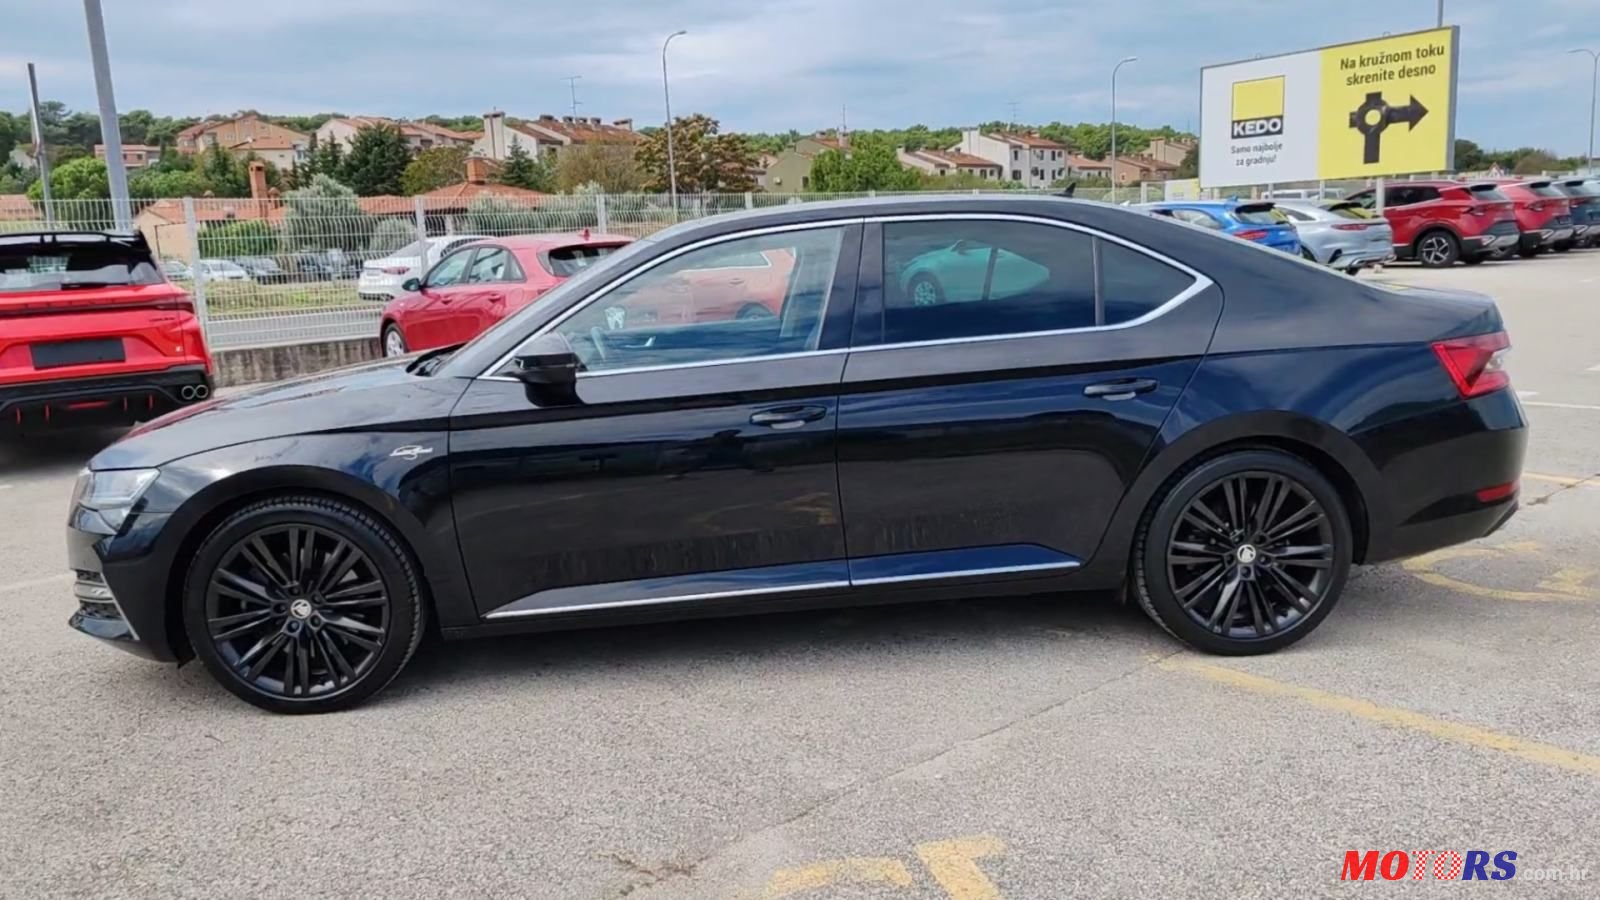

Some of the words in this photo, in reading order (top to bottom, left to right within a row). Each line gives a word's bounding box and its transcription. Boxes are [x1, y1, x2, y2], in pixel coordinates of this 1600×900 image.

[1340, 58, 1356, 70] Na
[1359, 51, 1412, 68] kružnom
[1416, 44, 1445, 59] toku
[1346, 68, 1395, 86] skrenite
[1398, 64, 1436, 79] desno
[1233, 118, 1281, 136] KEDO
[1231, 145, 1251, 154] Samo
